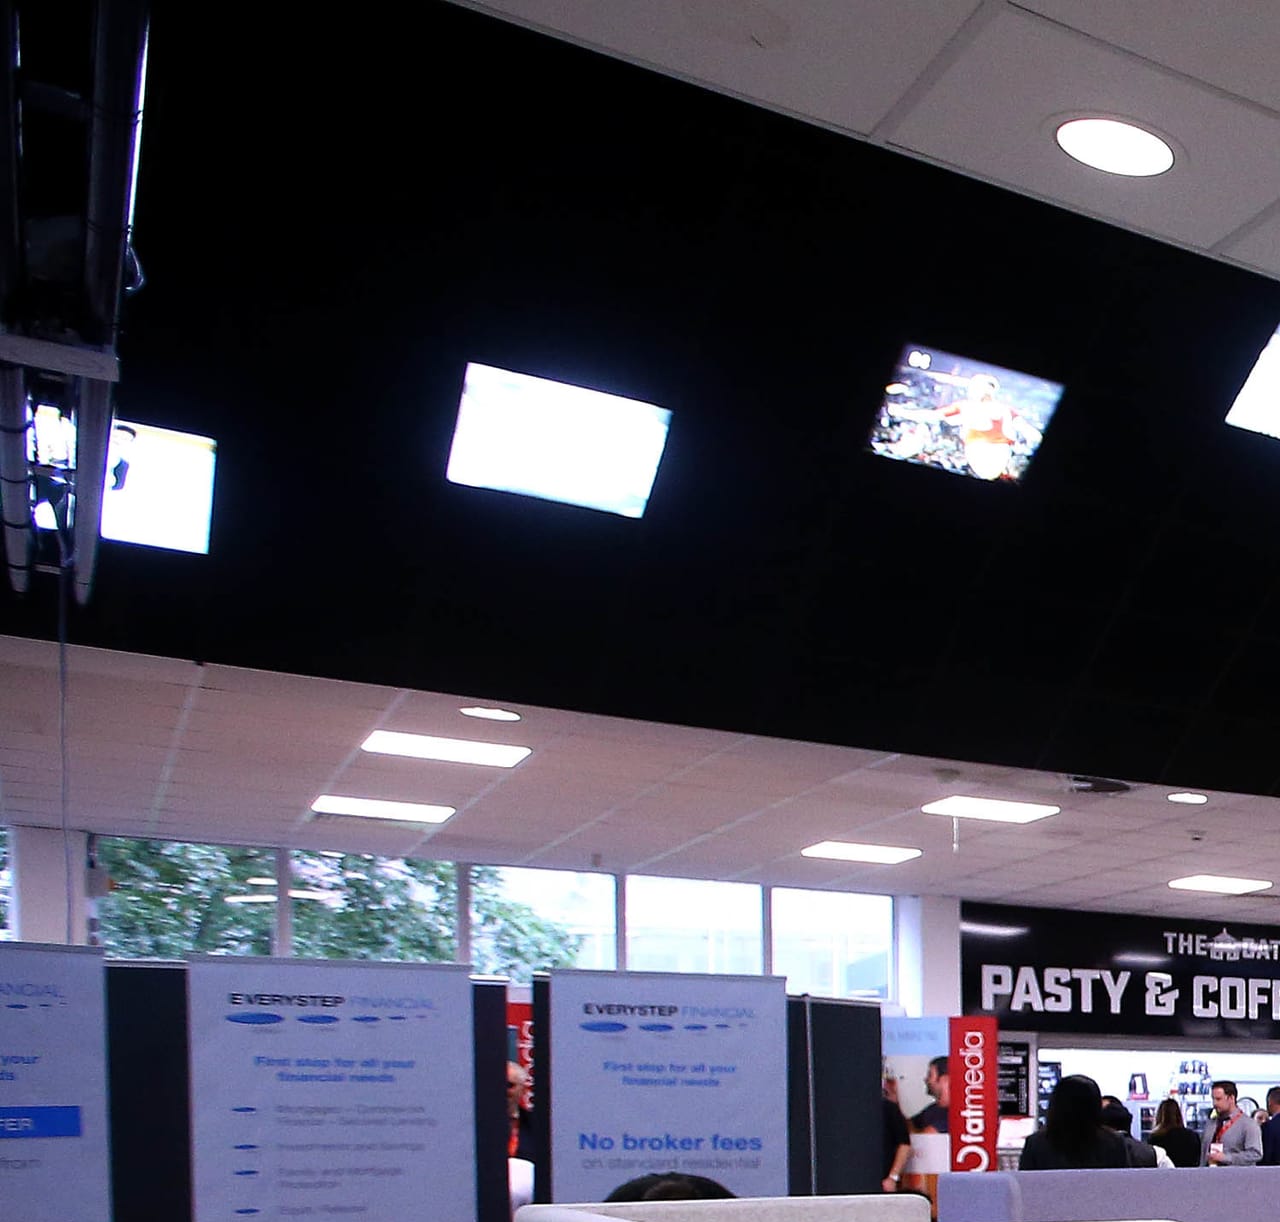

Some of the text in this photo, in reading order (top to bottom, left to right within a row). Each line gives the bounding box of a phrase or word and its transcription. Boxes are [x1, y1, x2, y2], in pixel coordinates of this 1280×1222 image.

[1163, 931, 1208, 956] THE
[229, 992, 346, 1008] EVERYSTEP
[981, 964, 1131, 1014] PASTY
[1145, 971, 1180, 1017] &
[583, 1002, 679, 1017] EVERYSTEP
[958, 1031, 986, 1144] fatmedia
[579, 1132, 764, 1151] No broker fees
